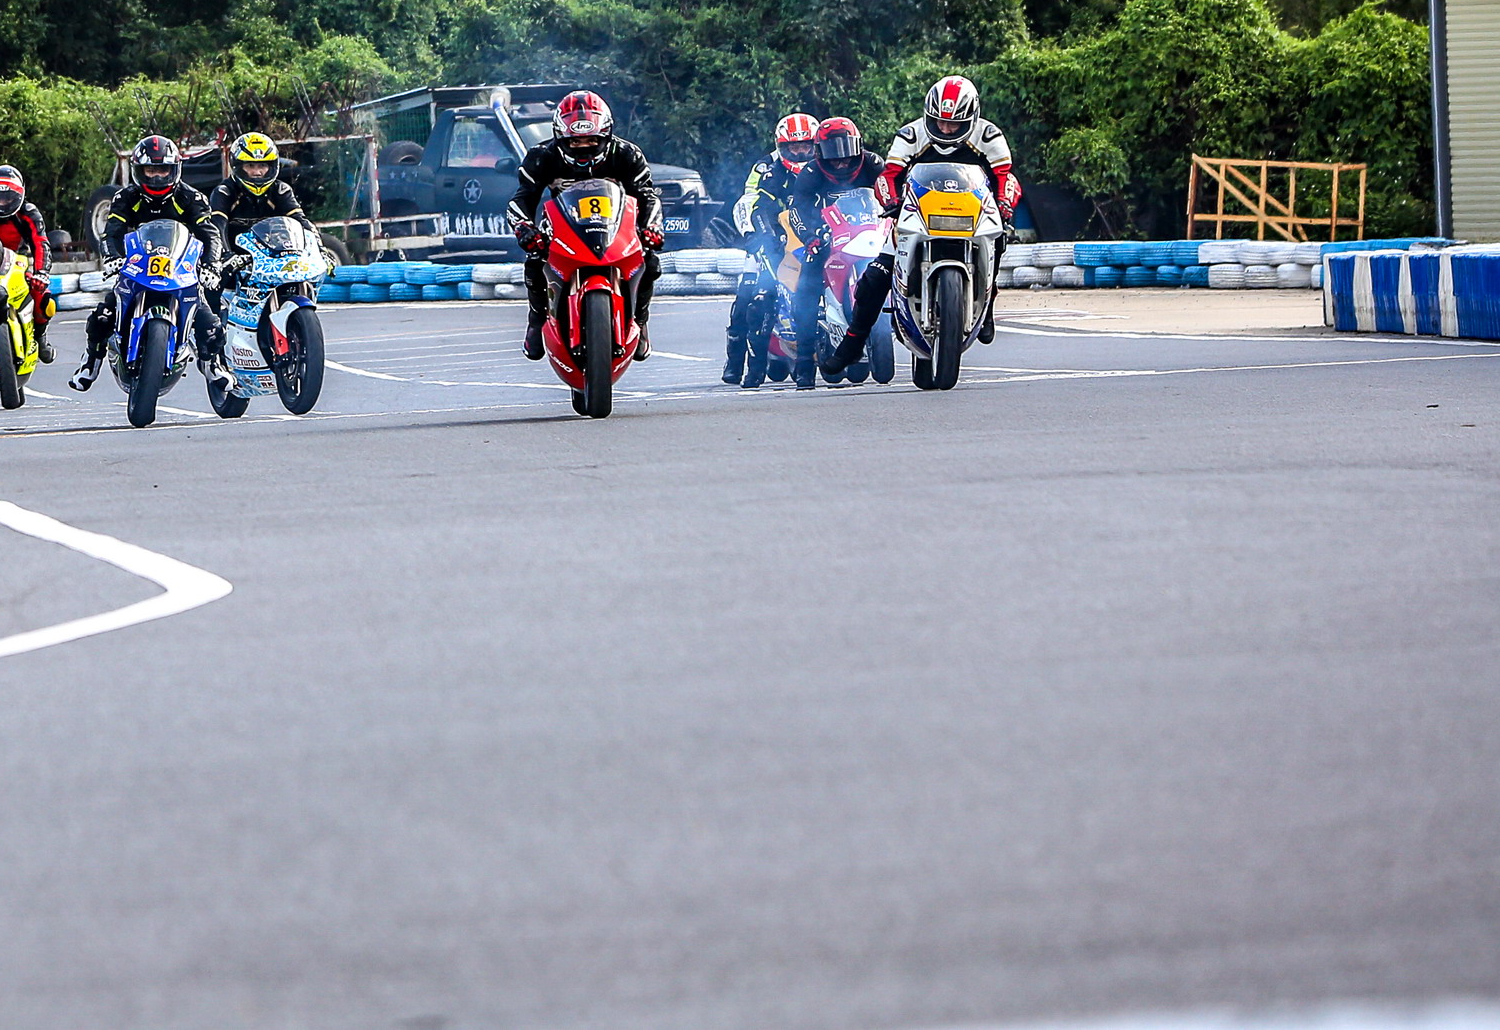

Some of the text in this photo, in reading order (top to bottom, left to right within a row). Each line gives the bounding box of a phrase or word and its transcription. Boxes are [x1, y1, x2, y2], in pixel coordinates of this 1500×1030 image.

[571, 121, 592, 131] Arai
[589, 198, 601, 216] 8
[665, 219, 689, 231] 25900
[150, 258, 171, 275] 64
